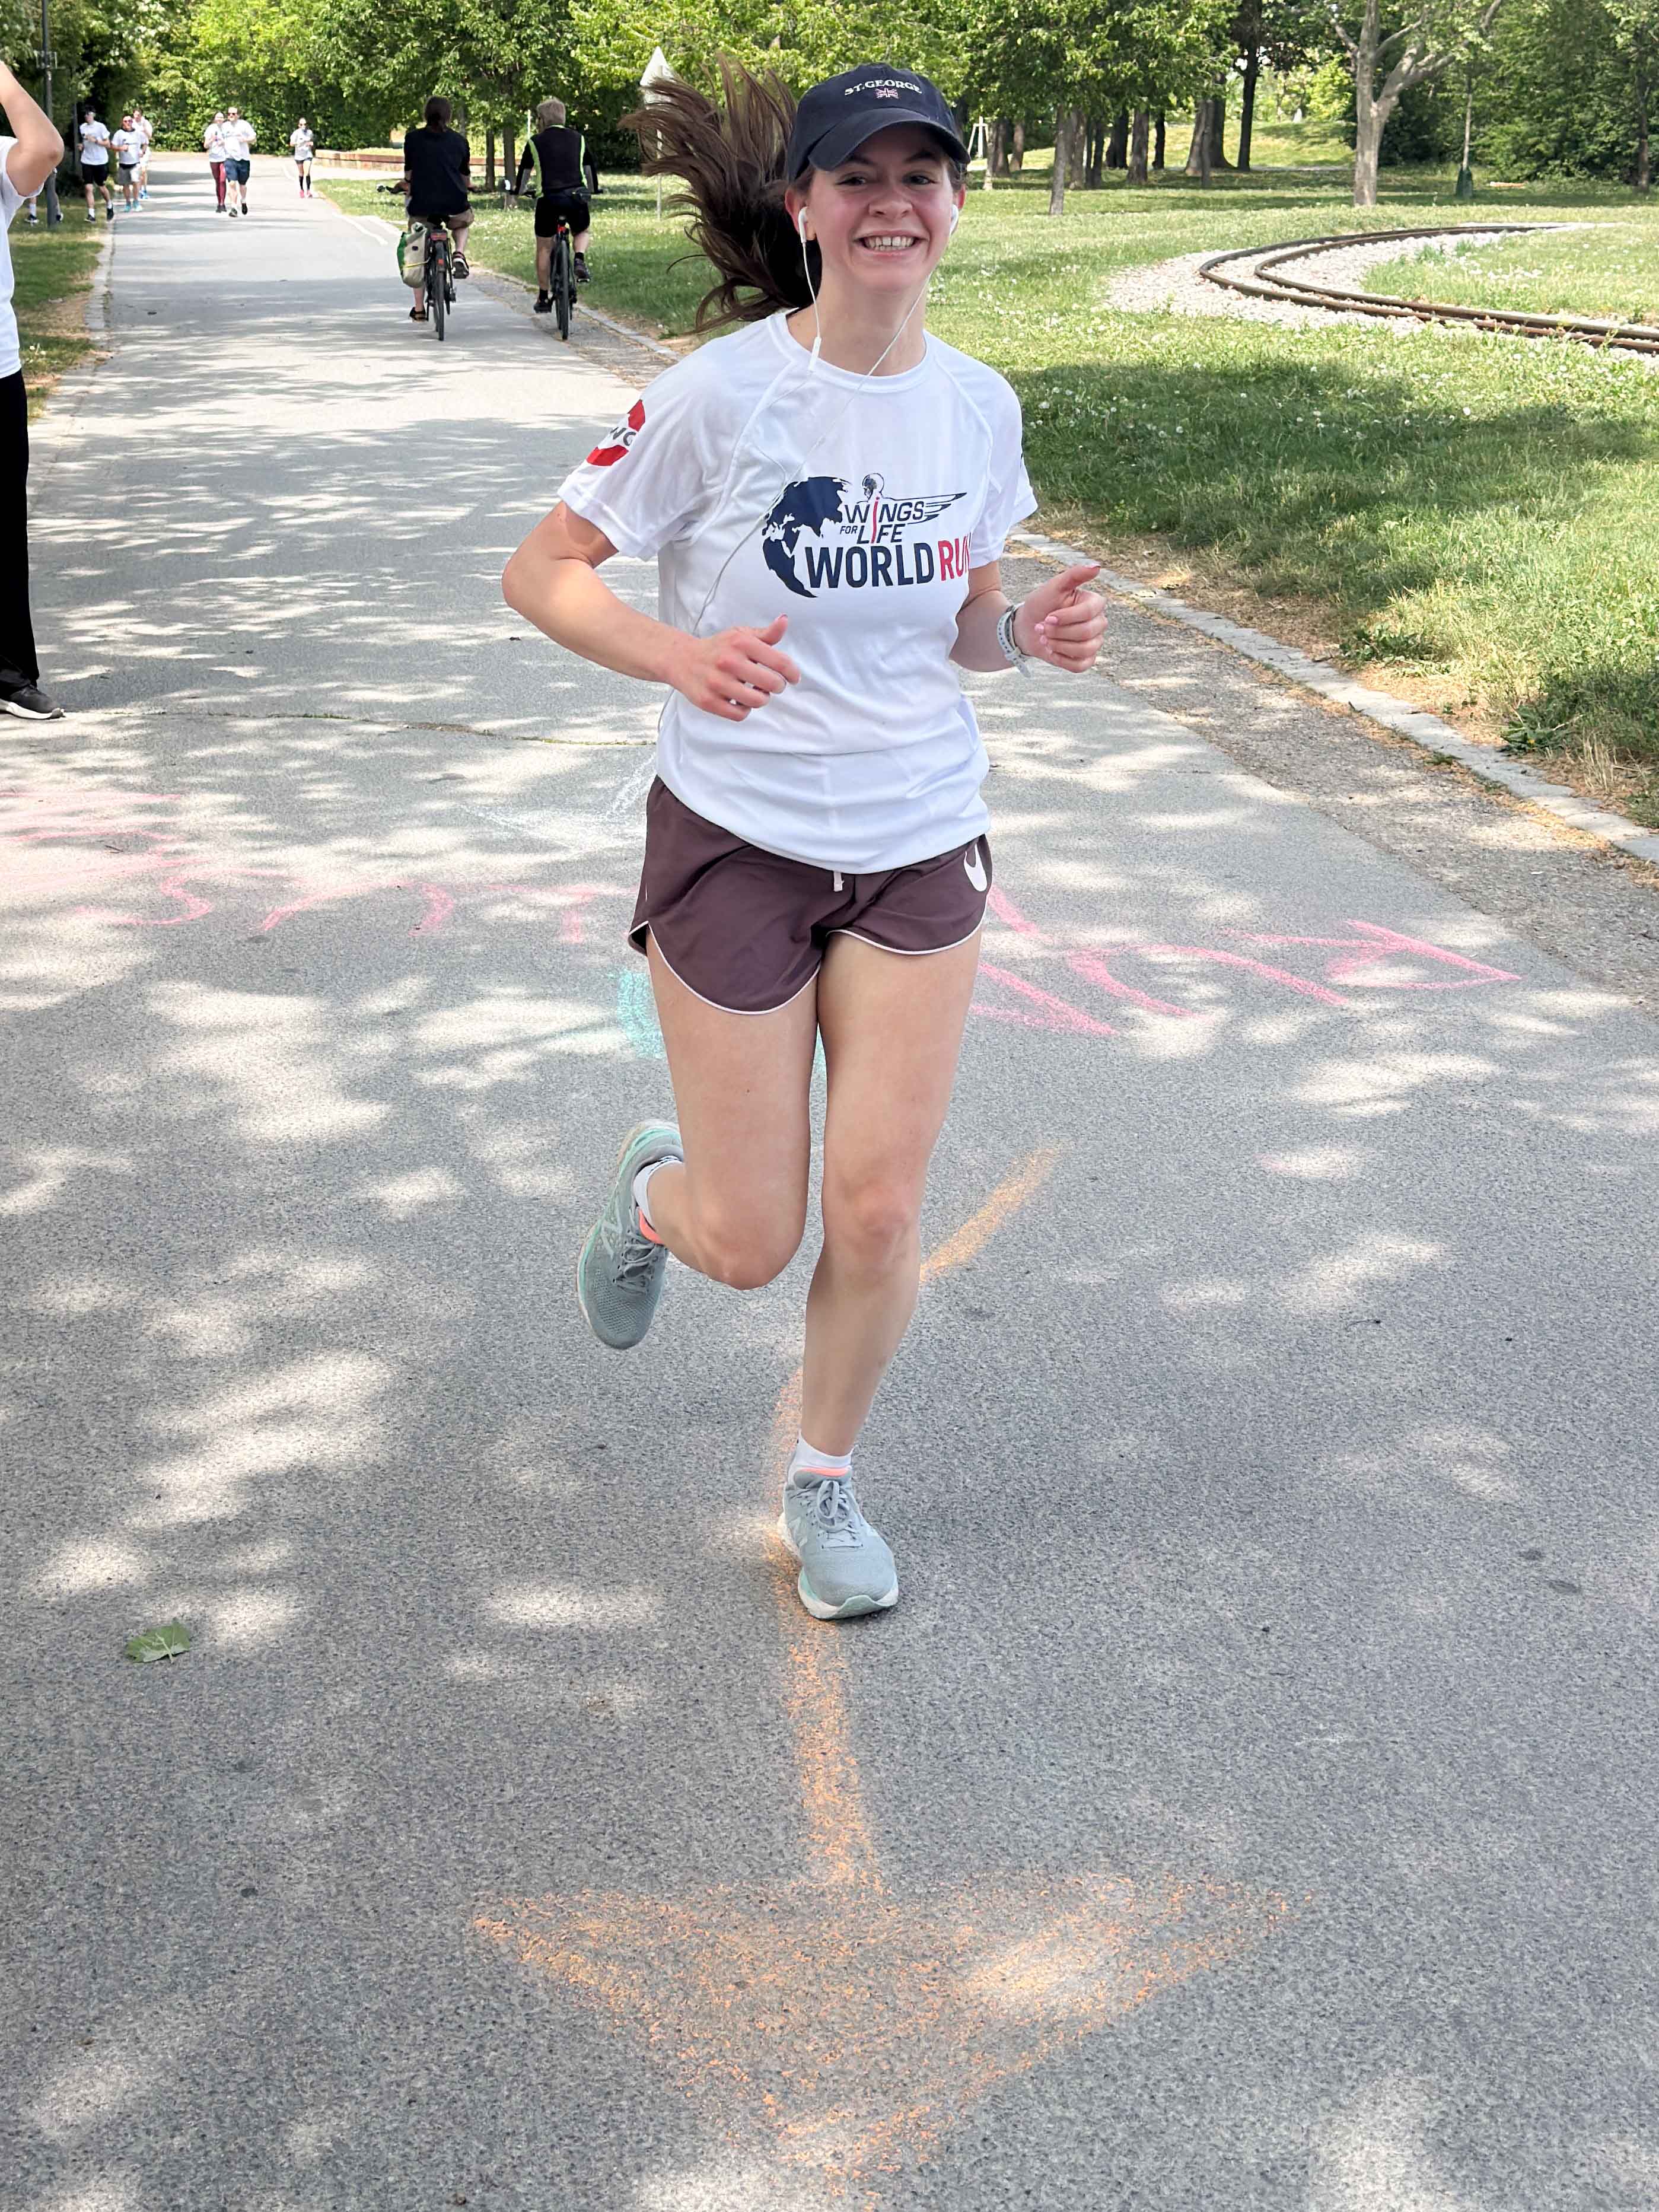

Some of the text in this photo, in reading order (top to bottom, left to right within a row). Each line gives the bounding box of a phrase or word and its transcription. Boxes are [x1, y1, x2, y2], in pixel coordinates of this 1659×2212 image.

[845, 501, 924, 524] WINGS
[840, 526, 857, 534] FOR
[856, 524, 906, 544] LIFE
[805, 543, 934, 588] WORLD
